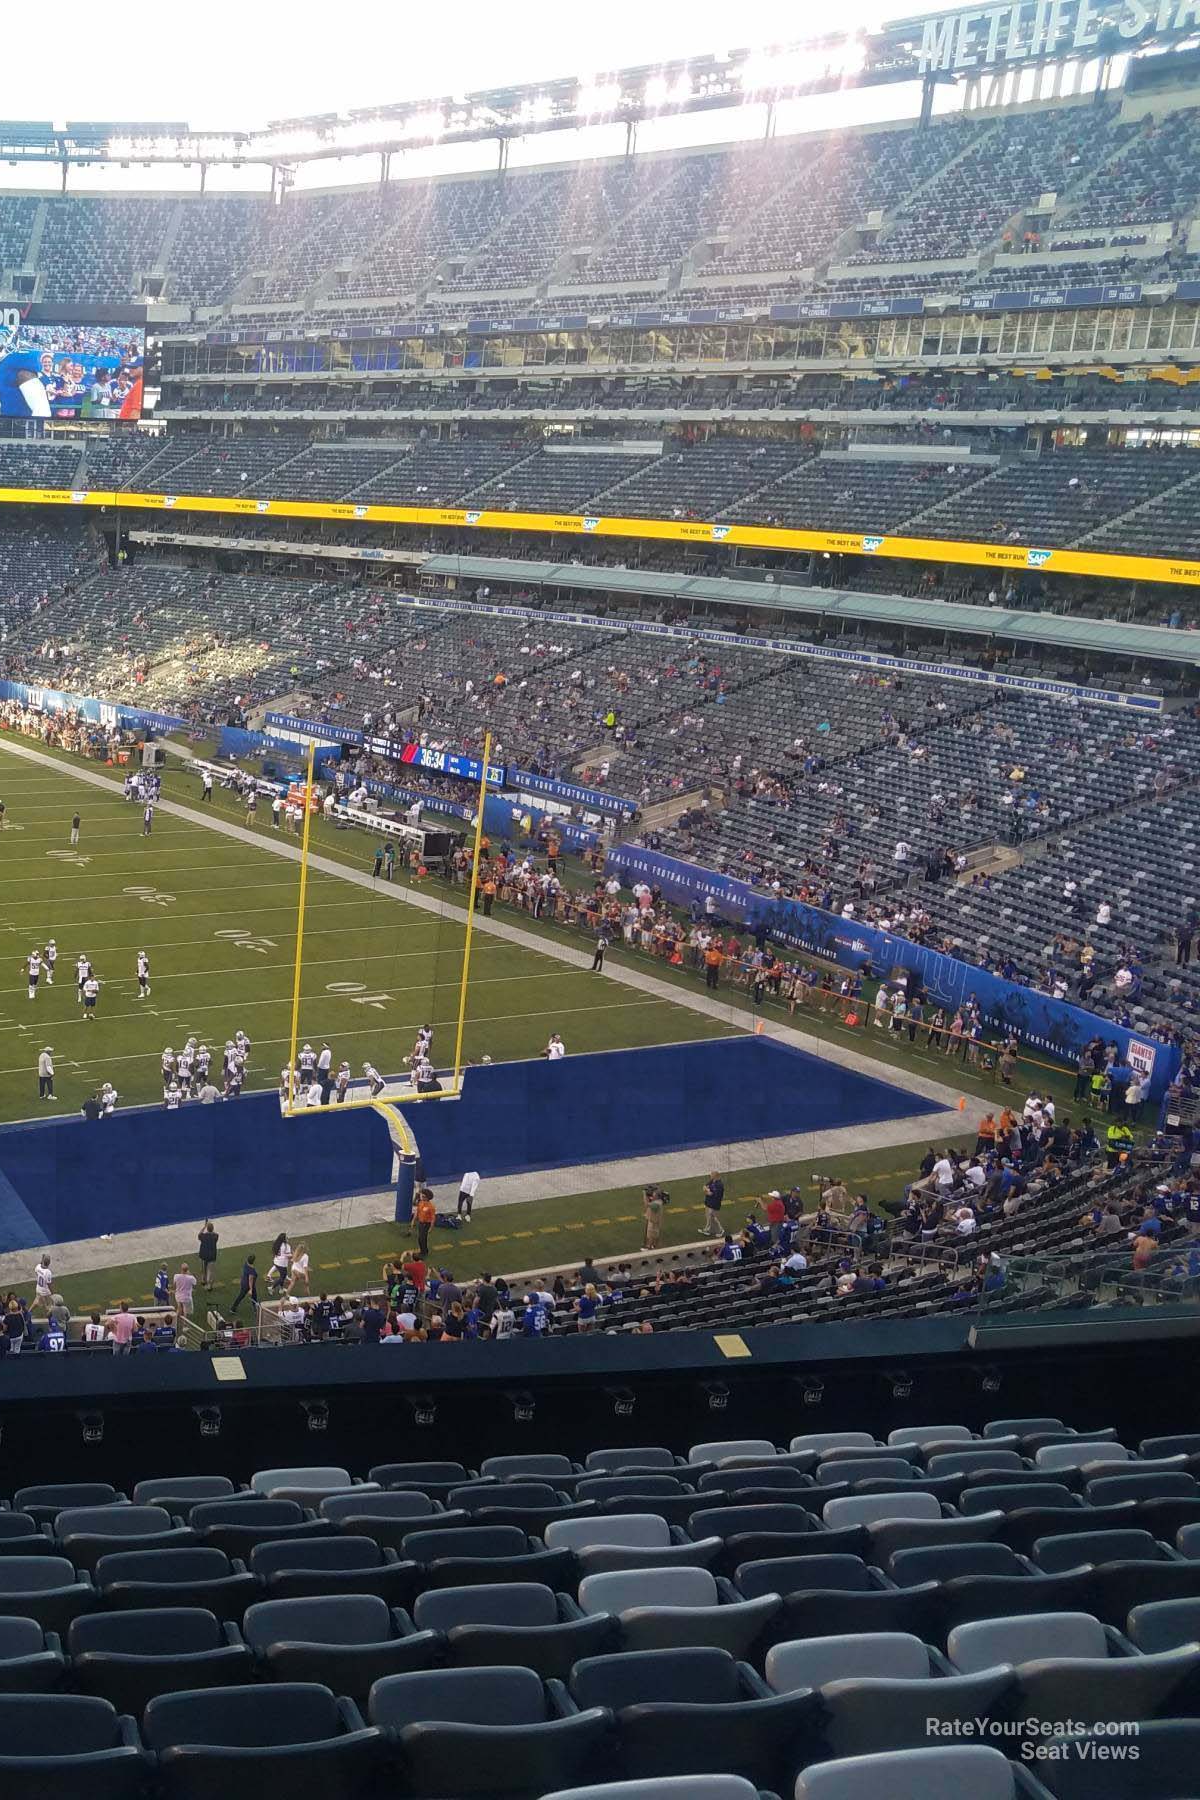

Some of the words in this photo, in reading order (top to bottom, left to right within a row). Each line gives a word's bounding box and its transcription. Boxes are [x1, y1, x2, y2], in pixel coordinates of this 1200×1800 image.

[712, 527, 728, 537] SAP
[863, 538, 880, 550] SAP
[362, 550, 384, 559] MetLife
[1028, 551, 1048, 565] SAP
[1184, 569, 1200, 577] BEST
[272, 716, 284, 724] NEW
[287, 719, 300, 729] YORK
[304, 723, 332, 736] FOOTBALL
[336, 731, 358, 742] GIANTS
[421, 749, 445, 771] 36:34
[516, 774, 530, 785] NEW
[535, 780, 553, 792] YORK
[557, 785, 594, 803] FOOTBALL
[653, 866, 691, 887] FOOTBALL
[325, 982, 396, 1008] 10
[984, 1014, 998, 1027] NEW
[1004, 1023, 1023, 1037] YORK
[1025, 1032, 1065, 1055] FOOTBALL
[1131, 1043, 1153, 1061] GIANTS
[50, 1338, 65, 1351] 97
